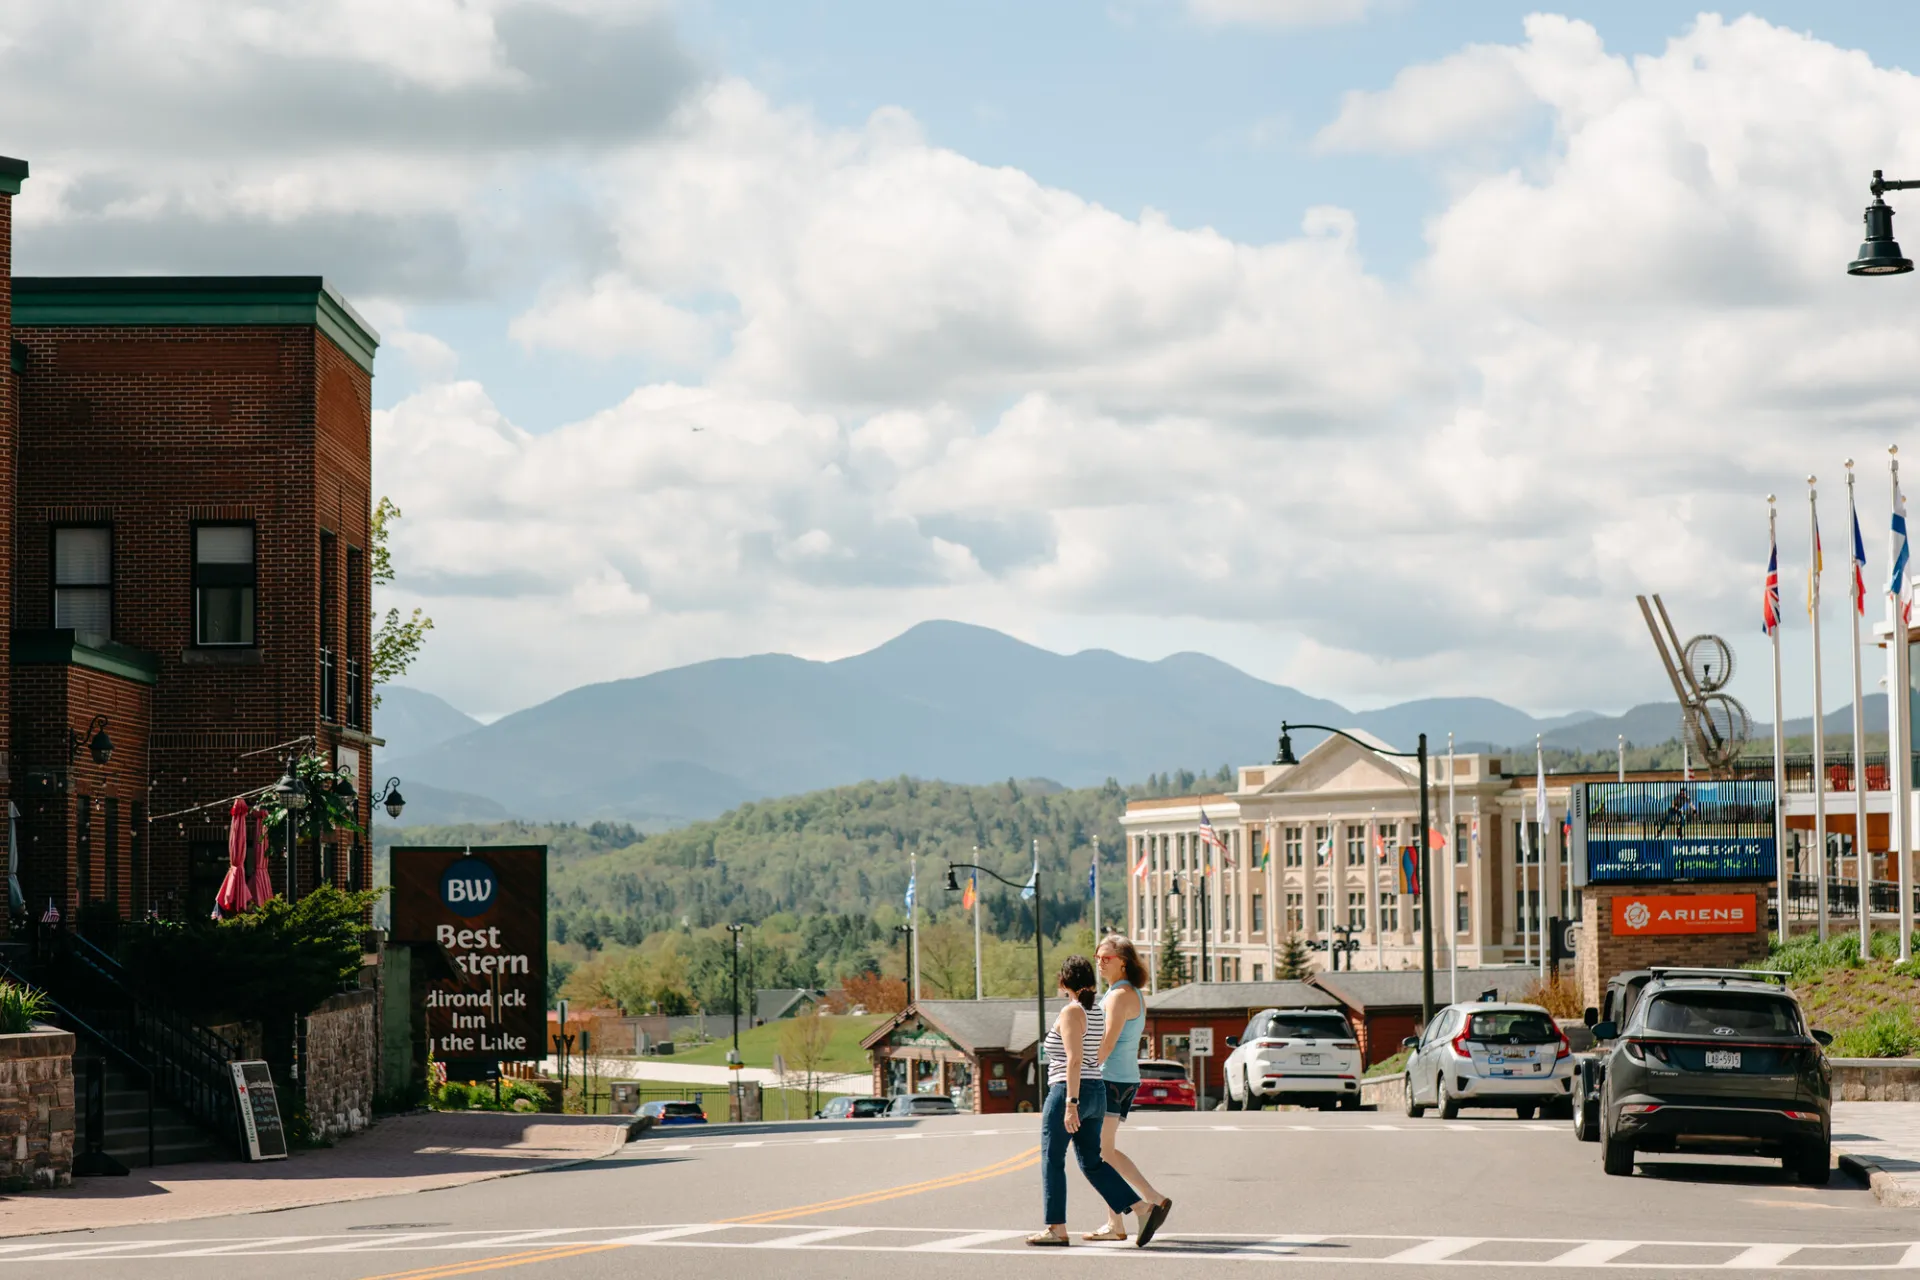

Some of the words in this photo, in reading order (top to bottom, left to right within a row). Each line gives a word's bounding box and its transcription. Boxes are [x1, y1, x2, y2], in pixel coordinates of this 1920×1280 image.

[448, 879, 491, 902] BW
[1657, 908, 1744, 921] ARIENS
[437, 924, 501, 949] Best
[455, 952, 530, 975] stern
[426, 988, 527, 1008] dirondck
[452, 1012, 486, 1029] Inn
[440, 1033, 474, 1051] the
